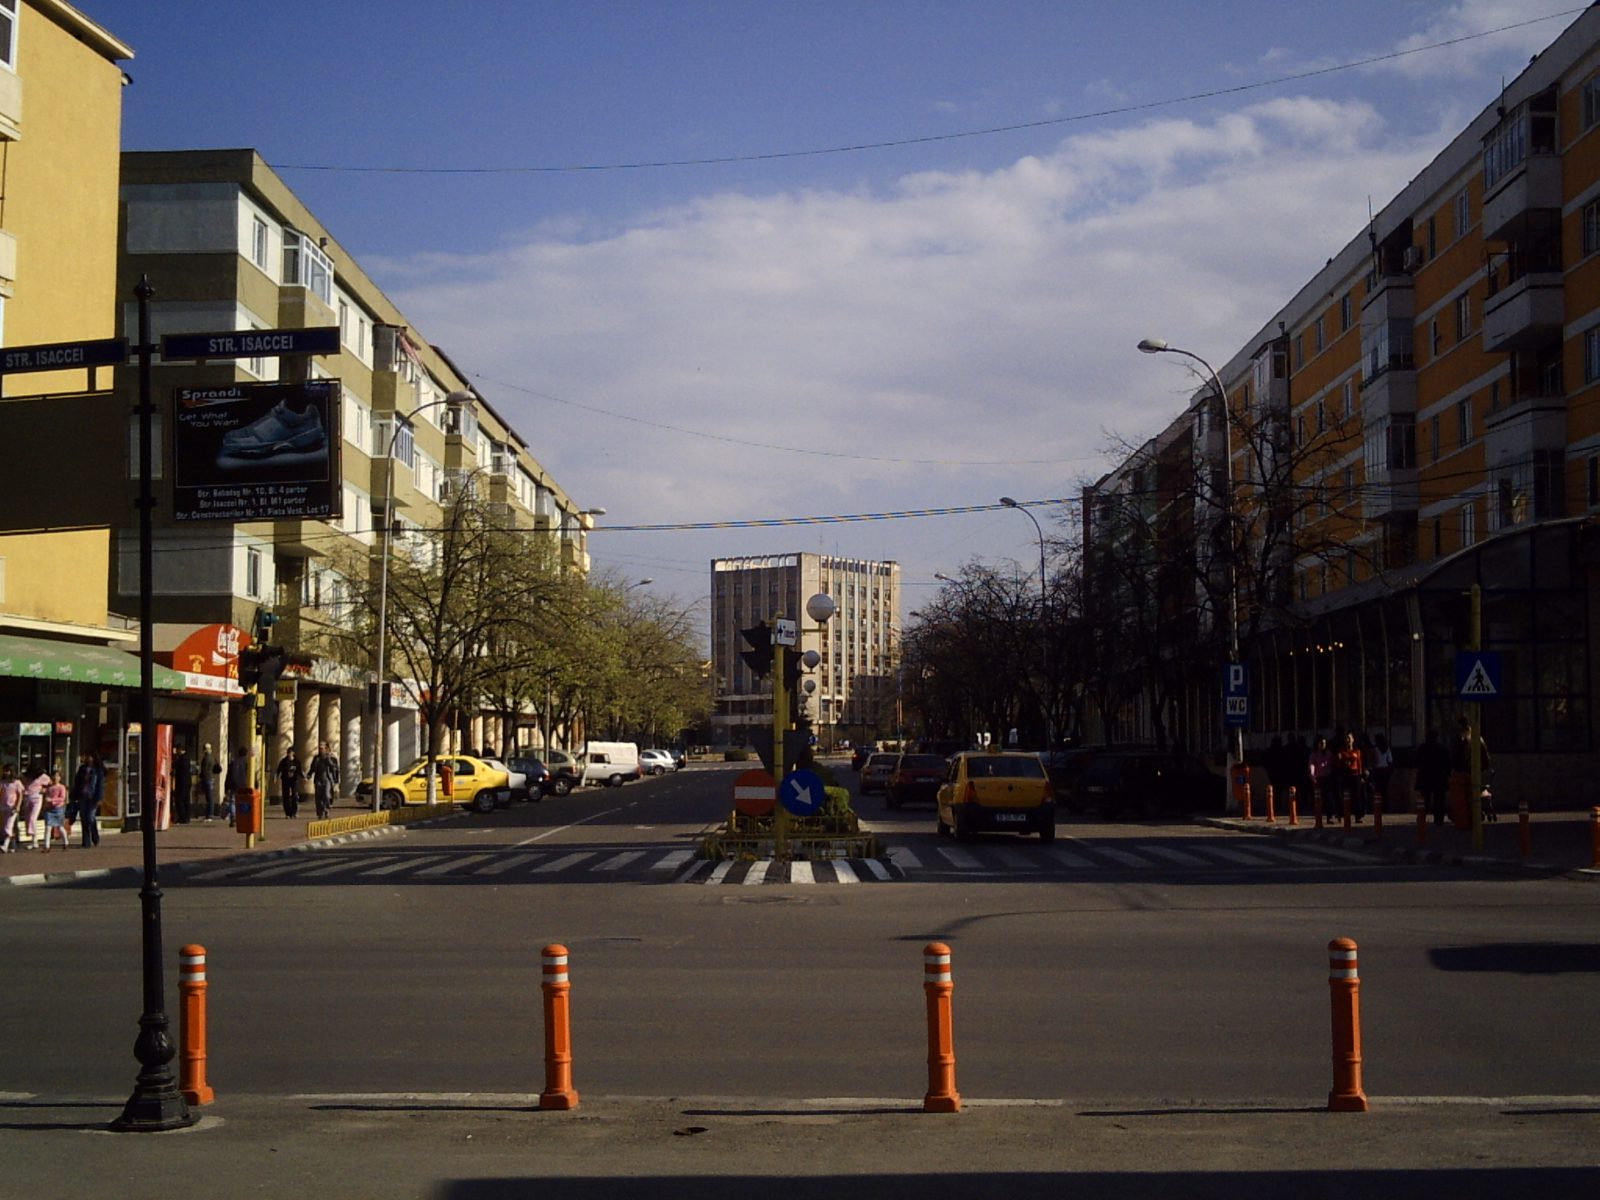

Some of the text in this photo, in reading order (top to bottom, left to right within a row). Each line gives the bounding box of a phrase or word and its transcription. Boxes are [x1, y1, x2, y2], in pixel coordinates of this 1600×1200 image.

[208, 335, 294, 353] STR. ISACCEI
[5, 348, 84, 368] STR. ISACCEI
[181, 387, 241, 402] Sprandi
[1229, 664, 1243, 692] P
[1228, 698, 1245, 712] WC
